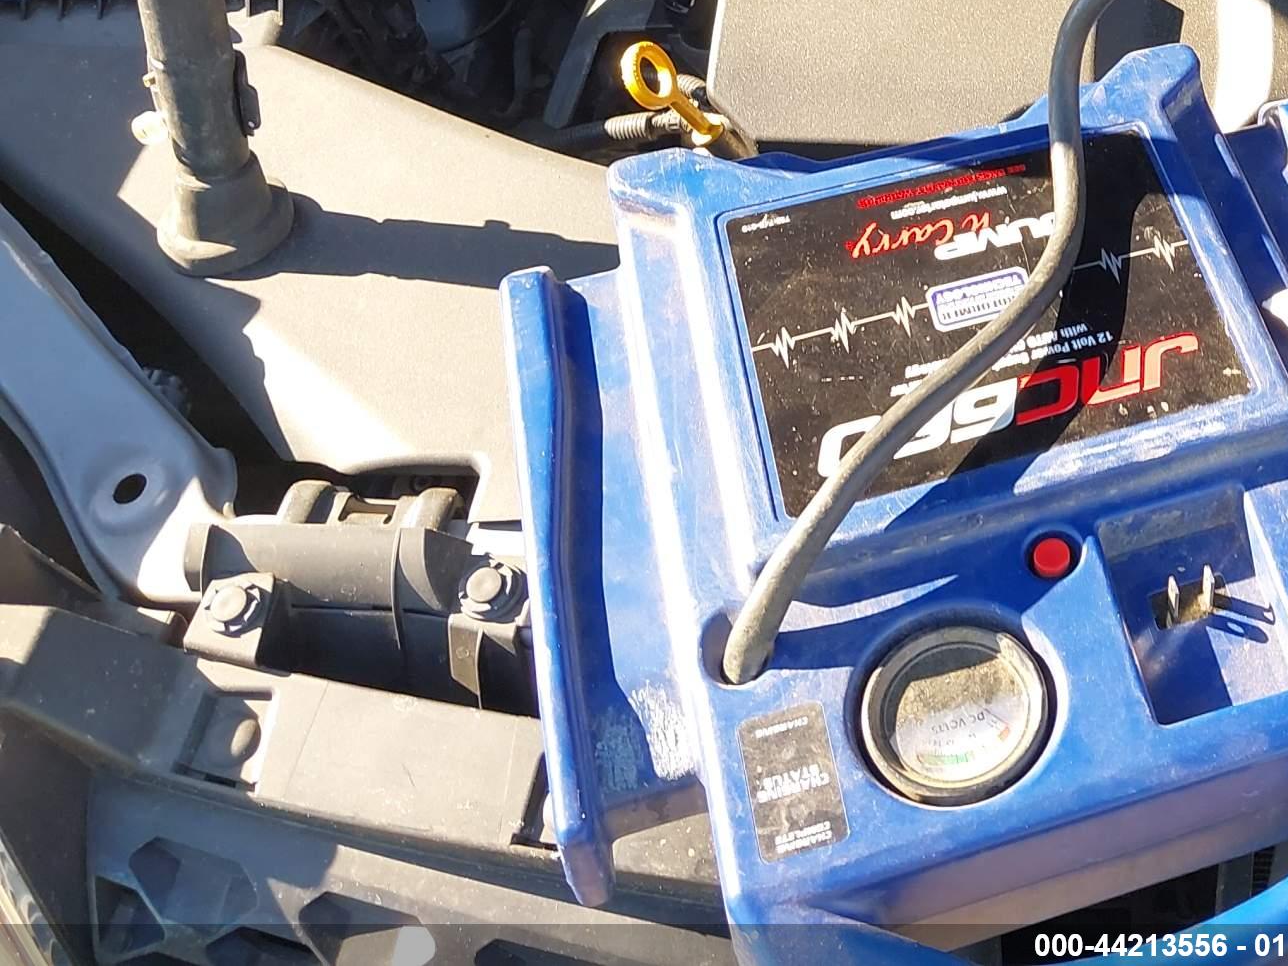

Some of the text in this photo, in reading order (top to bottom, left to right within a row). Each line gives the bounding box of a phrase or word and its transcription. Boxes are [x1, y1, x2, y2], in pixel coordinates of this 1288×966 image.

[851, 216, 955, 260] Carry
[1059, 322, 1088, 339] with
[1095, 329, 1113, 344] 12
[1029, 340, 1070, 360] Power
[1070, 333, 1096, 350] Volt
[931, 718, 967, 735] VOLTS
